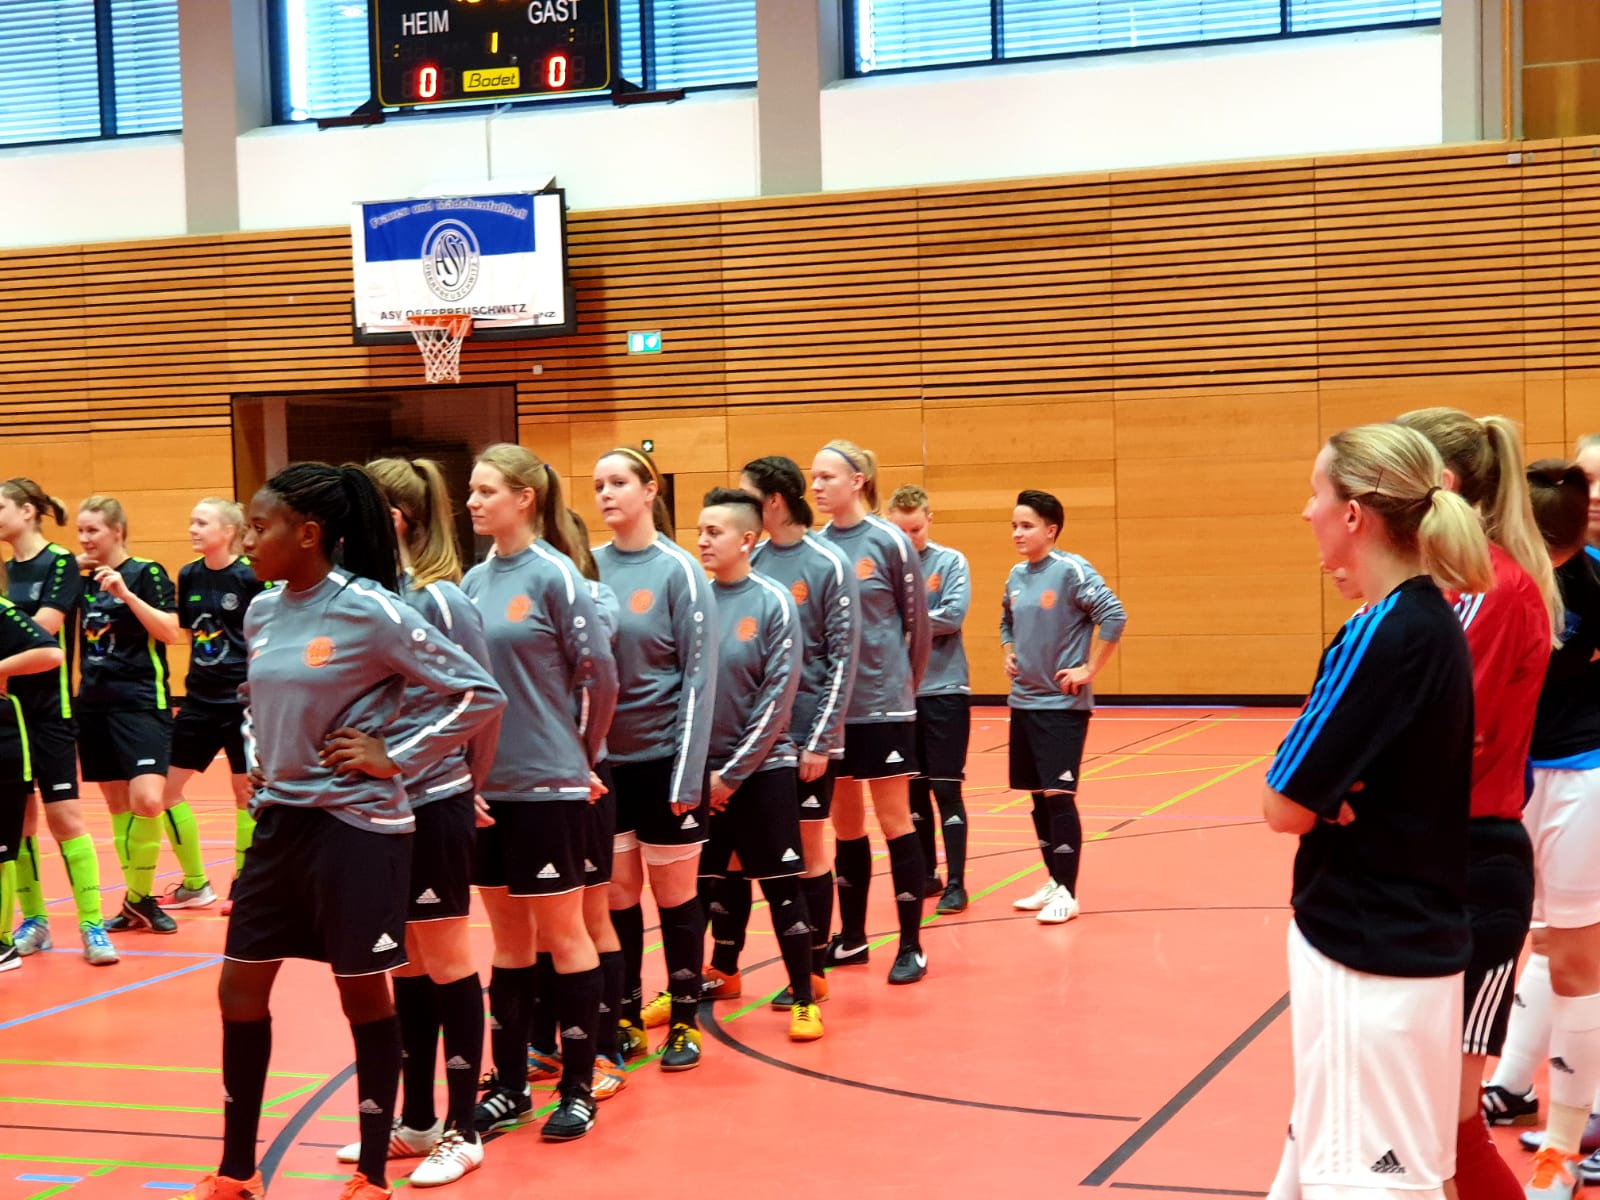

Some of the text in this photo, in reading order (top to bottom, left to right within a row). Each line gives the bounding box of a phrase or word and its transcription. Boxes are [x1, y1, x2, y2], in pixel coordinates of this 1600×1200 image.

[402, 10, 450, 36] HEIM
[528, 0, 580, 25] GAST
[418, 67, 438, 98] 0
[467, 71, 516, 90] Bodet
[547, 56, 567, 88] 0
[380, 310, 403, 321] ASV
